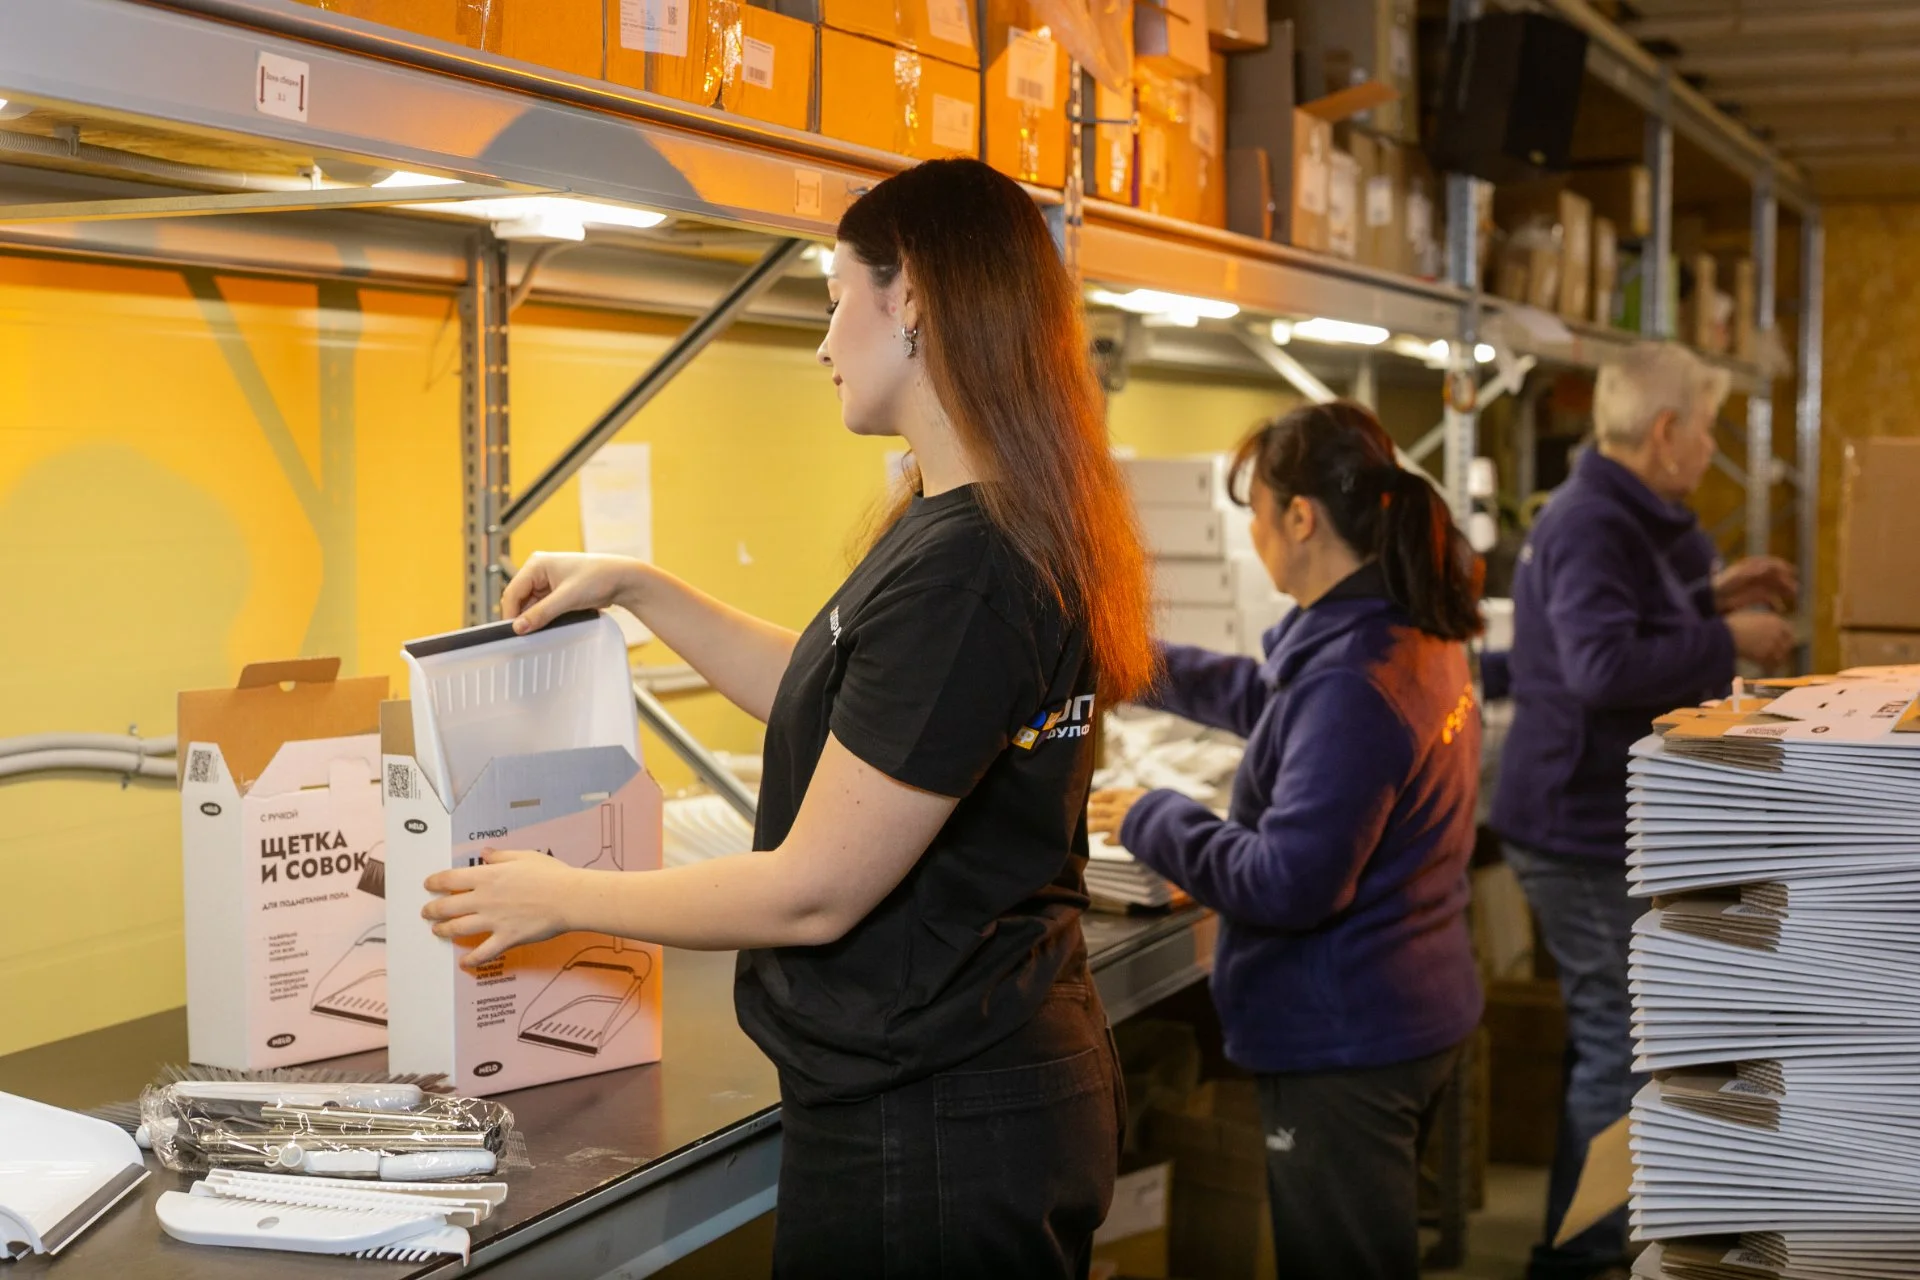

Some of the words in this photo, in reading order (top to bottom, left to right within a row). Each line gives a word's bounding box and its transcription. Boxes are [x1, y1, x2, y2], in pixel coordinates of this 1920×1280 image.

[260, 812, 266, 823] С
[268, 809, 299, 822] РУЧКОЙ
[469, 832, 475, 841] С
[476, 827, 508, 840] РУЧКОЙ
[260, 829, 348, 860] ЩЕТКА
[261, 864, 278, 885] И
[285, 851, 368, 881] СОВОК
[262, 900, 279, 911] ДЛЯ
[279, 895, 328, 908] ПОДМЕТАНИЯ
[329, 892, 349, 902] ПОЛА
